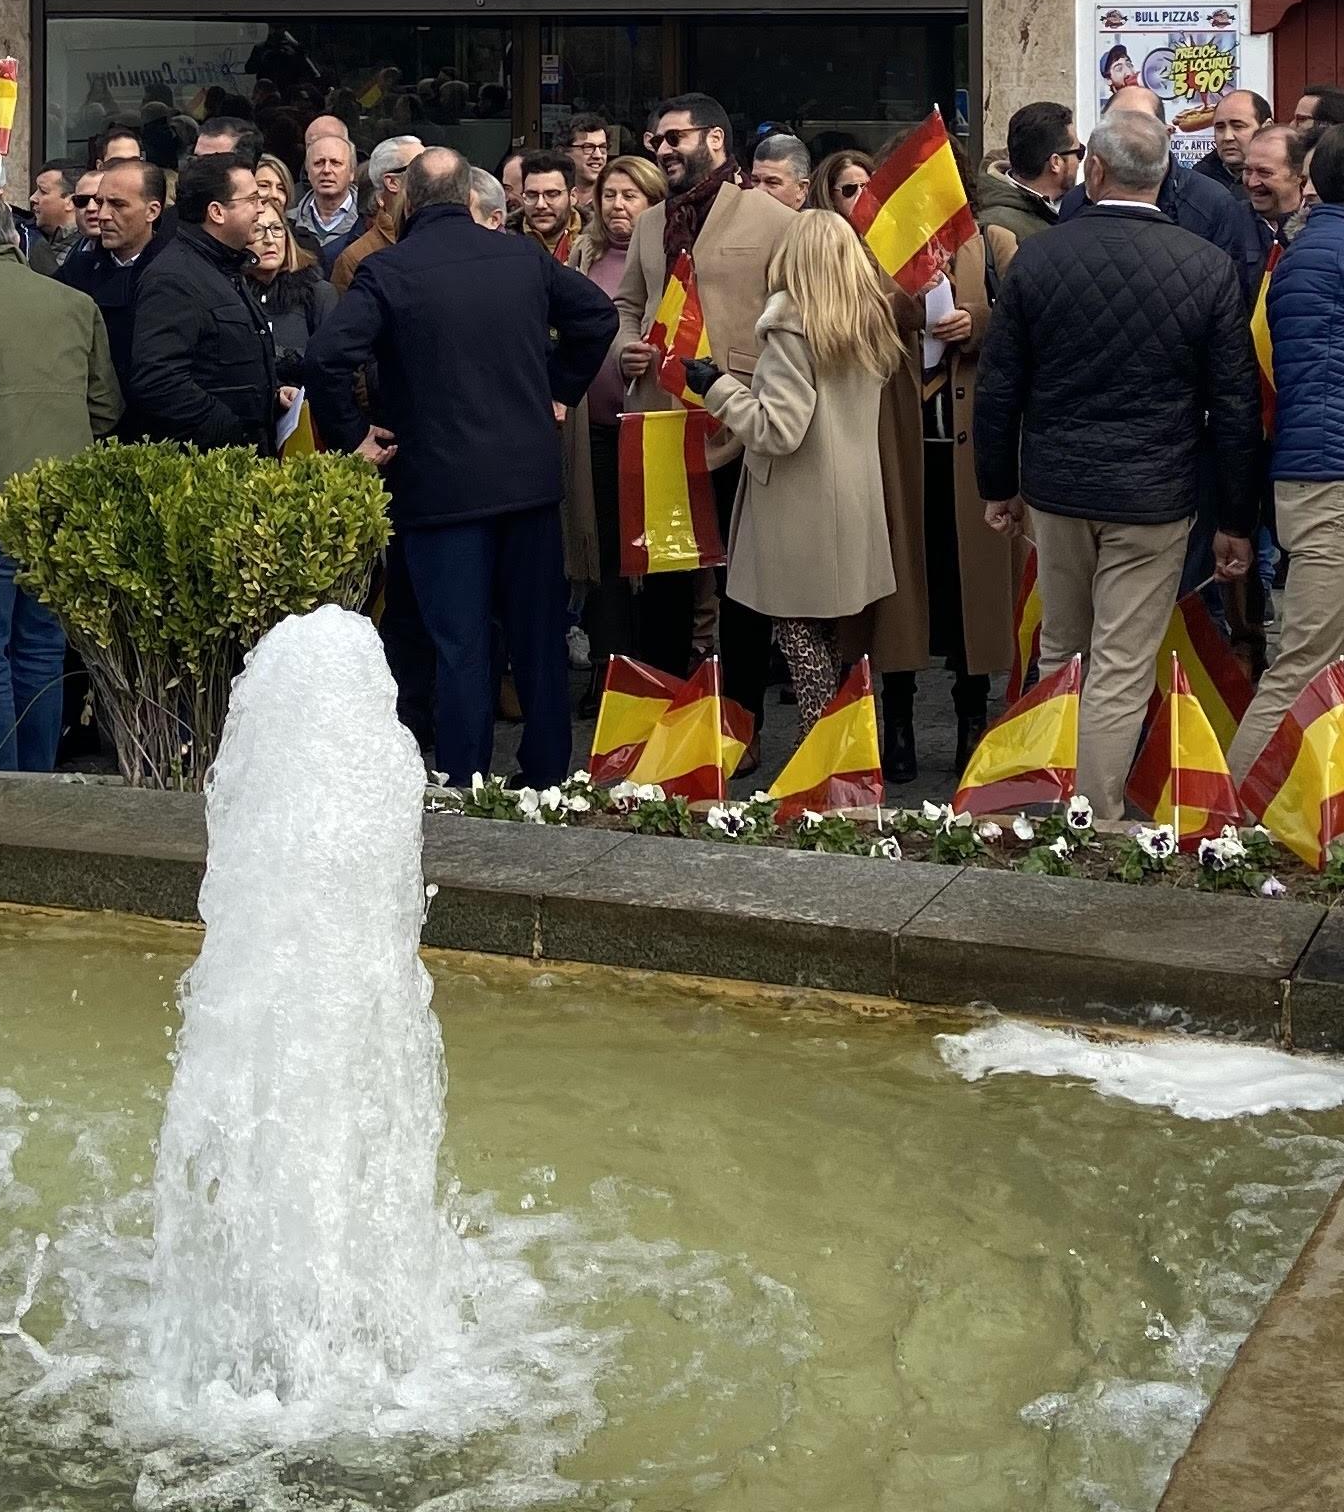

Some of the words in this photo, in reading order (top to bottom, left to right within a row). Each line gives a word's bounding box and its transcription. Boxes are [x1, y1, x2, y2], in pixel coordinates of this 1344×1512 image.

[1135, 11, 1160, 23] BULL
[1162, 11, 1200, 22] PIZZAS
[1191, 140, 1216, 150] ARTES
